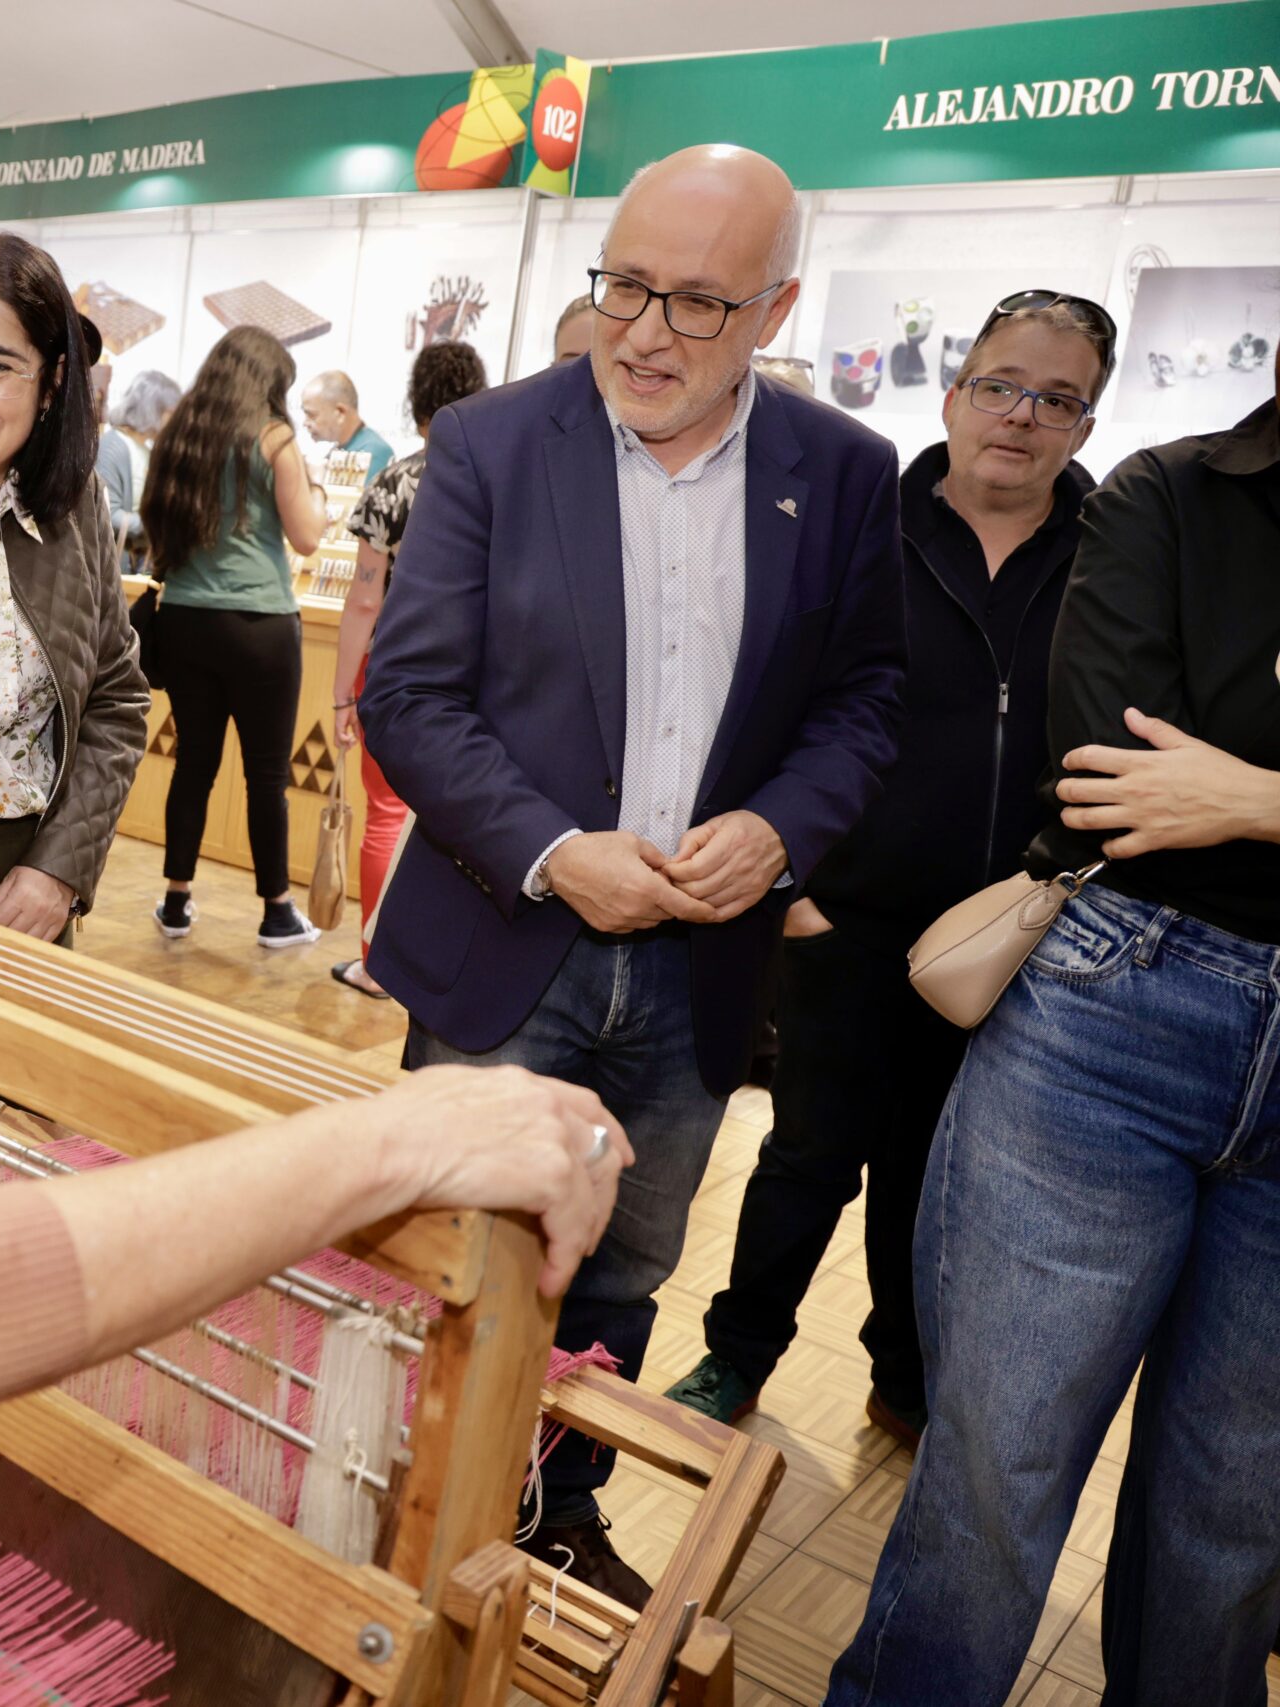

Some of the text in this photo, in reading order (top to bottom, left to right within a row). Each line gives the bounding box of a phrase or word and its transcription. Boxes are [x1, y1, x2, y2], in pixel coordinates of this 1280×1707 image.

[883, 66, 1280, 131] ALEJANDRO TORN
[542, 104, 577, 143] 102
[87, 151, 117, 178] DE
[118, 139, 206, 174] MADERA
